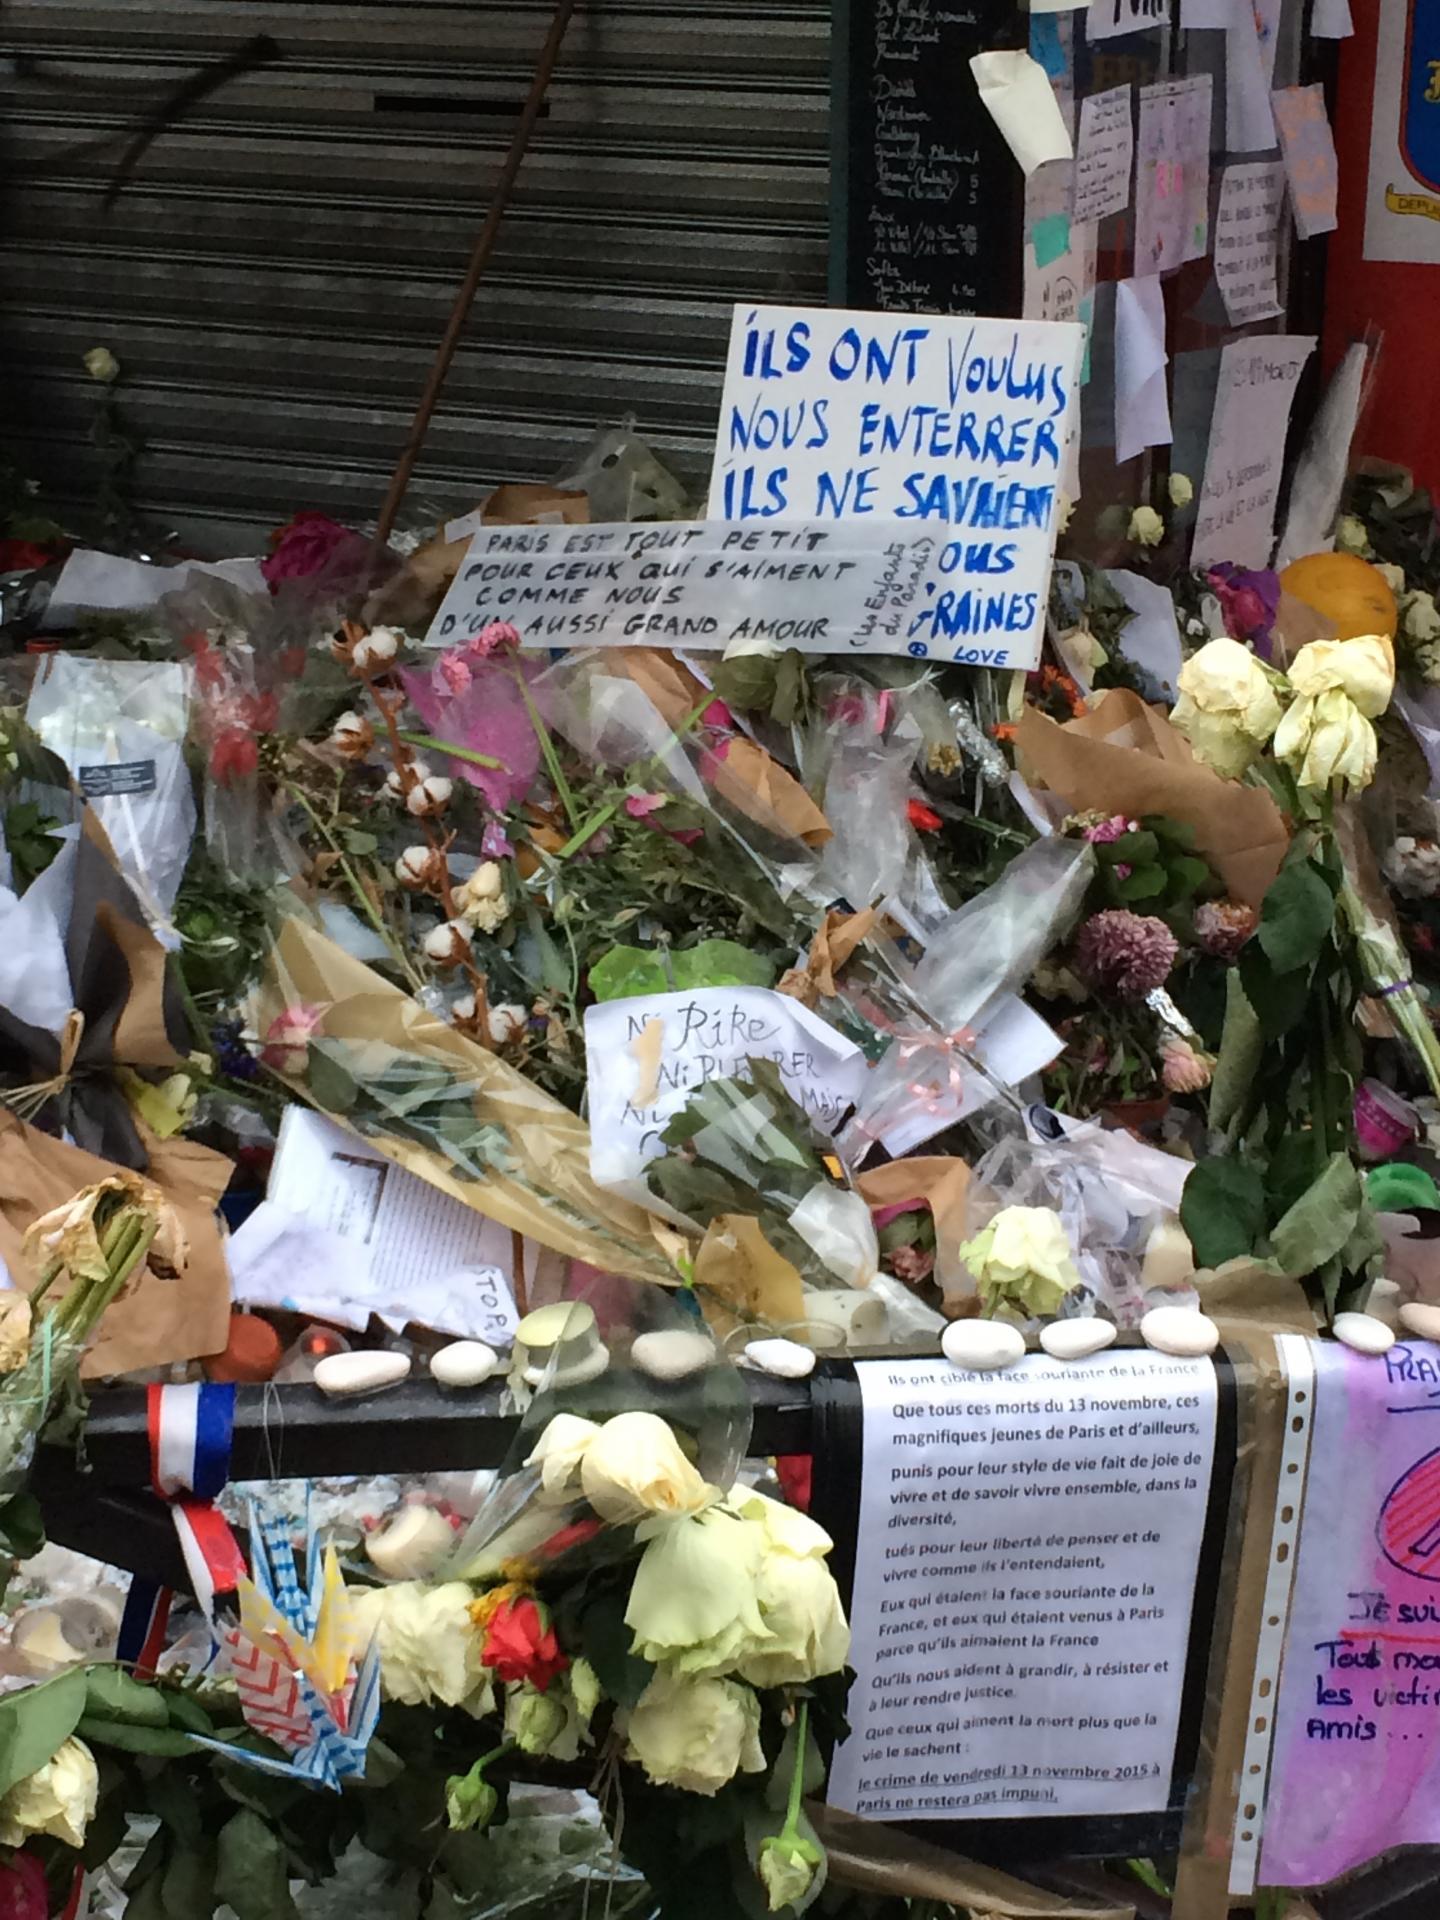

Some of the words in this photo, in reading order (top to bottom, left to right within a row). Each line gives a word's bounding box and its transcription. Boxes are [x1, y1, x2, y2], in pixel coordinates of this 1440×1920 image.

[829, 328, 930, 385] ONT
[730, 393, 829, 452] NOUS
[859, 404, 1058, 470] ENTERRER
[816, 467, 880, 518] NE
[563, 532, 615, 553] EST
[624, 530, 704, 551] TOUT
[464, 562, 535, 581] POUR
[545, 560, 624, 581] CEUX
[475, 586, 589, 606] COMME
[604, 586, 685, 605] NOUS
[623, 613, 718, 635] GRAND
[729, 617, 829, 640] AMOUR
[953, 646, 1009, 664] LOVE
[911, 1375, 935, 1384] ont
[1109, 1366, 1127, 1376] de
[1132, 1366, 1145, 1376] la
[1149, 1364, 1199, 1374] France
[1382, 1345, 1440, 1383] PRA
[893, 1404, 924, 1419] Que
[928, 1403, 962, 1416] tous
[967, 1404, 991, 1415] ces
[996, 1401, 1039, 1414] morts
[1045, 1399, 1063, 1413] du
[1070, 1399, 1085, 1411] 13
[1091, 1396, 1171, 1411] novembre,
[1177, 1396, 1199, 1408] ces
[893, 1429, 987, 1447] magnifiques
[991, 1428, 1041, 1445] jeunes
[1046, 1425, 1064, 1439] de
[1069, 1424, 1105, 1438] Paris
[1109, 1424, 1124, 1437] et
[891, 1463, 932, 1481] punis
[937, 1465, 973, 1479] pour
[978, 1462, 1007, 1475] leur
[1011, 1459, 1047, 1475] style
[1052, 1458, 1070, 1472] de
[1075, 1457, 1096, 1470] vie
[1101, 1456, 1125, 1469] fait
[1130, 1455, 1148, 1468] de
[1151, 1453, 1179, 1469] joie
[1184, 1452, 1201, 1465] de
[890, 1491, 927, 1504] vivre
[932, 1489, 947, 1502] et
[952, 1487, 970, 1500] de
[975, 1485, 1019, 1500] savoir
[1024, 1484, 1060, 1497] vivre
[1065, 1479, 1141, 1495] ensemble,
[1146, 1479, 1180, 1490] dans
[1184, 1477, 1197, 1489] la
[888, 1512, 956, 1528] diversité,
[885, 1542, 915, 1559] tués
[919, 1543, 956, 1557] pour
[960, 1540, 987, 1552] leur
[993, 1536, 1042, 1550] liberté
[1046, 1534, 1064, 1546] de
[1068, 1533, 1119, 1548] penser
[1122, 1532, 1138, 1543] et
[1142, 1530, 1160, 1543] de
[883, 1568, 917, 1582] vivre
[922, 1563, 977, 1577] comme
[981, 1560, 997, 1573] ils
[881, 1600, 904, 1613] Eux
[909, 1593, 931, 1610] qui
[935, 1590, 987, 1605] étaient
[992, 1588, 1005, 1600] la
[1011, 1587, 1041, 1600] face
[1045, 1585, 1116, 1599] souriante
[1120, 1585, 1138, 1597] de
[1142, 1583, 1155, 1596] la
[879, 1619, 928, 1636] France,
[933, 1615, 947, 1628] et
[952, 1614, 978, 1626] eux
[982, 1611, 1006, 1625] qui
[1011, 1610, 1065, 1624] étaient
[1069, 1611, 1113, 1623] venus
[1117, 1609, 1125, 1621] à
[1129, 1606, 1165, 1620] Paris
[875, 1644, 914, 1662] parce
[960, 1634, 1027, 1648] aimaient
[1032, 1635, 1044, 1647] la
[1050, 1634, 1099, 1647] France
[916, 1669, 950, 1684] nous
[954, 1663, 1000, 1677] aident
[1005, 1662, 1014, 1676] à
[1019, 1663, 1078, 1679] grandir,
[1083, 1663, 1091, 1676] à
[1096, 1661, 1150, 1676] résister
[1154, 1660, 1168, 1673] et
[869, 1700, 876, 1712] à
[881, 1697, 908, 1709] leur
[913, 1691, 961, 1706] rendre
[1316, 1674, 1353, 1705] les
[865, 1726, 893, 1740] Que
[898, 1722, 932, 1735] ceux
[936, 1718, 959, 1734] qui
[963, 1714, 1014, 1730] aiment
[1019, 1714, 1032, 1727] la
[1078, 1716, 1109, 1730] plus
[1114, 1716, 1140, 1730] que
[1145, 1713, 1157, 1726] la
[862, 1750, 883, 1762] vie
[887, 1746, 899, 1758] le
[904, 1742, 961, 1757] sachent
[875, 1774, 916, 1787] crime
[920, 1772, 938, 1784] de
[944, 1764, 1005, 1783] vendredi
[1012, 1765, 1027, 1776] 13
[1033, 1766, 1110, 1778] novembre
[1114, 1764, 1147, 1779] 2015
[1152, 1763, 1160, 1777] à
[856, 1797, 890, 1812] Paris
[896, 1799, 913, 1808] ne
[918, 1796, 970, 1807] restera
[974, 1790, 997, 1804] pas
